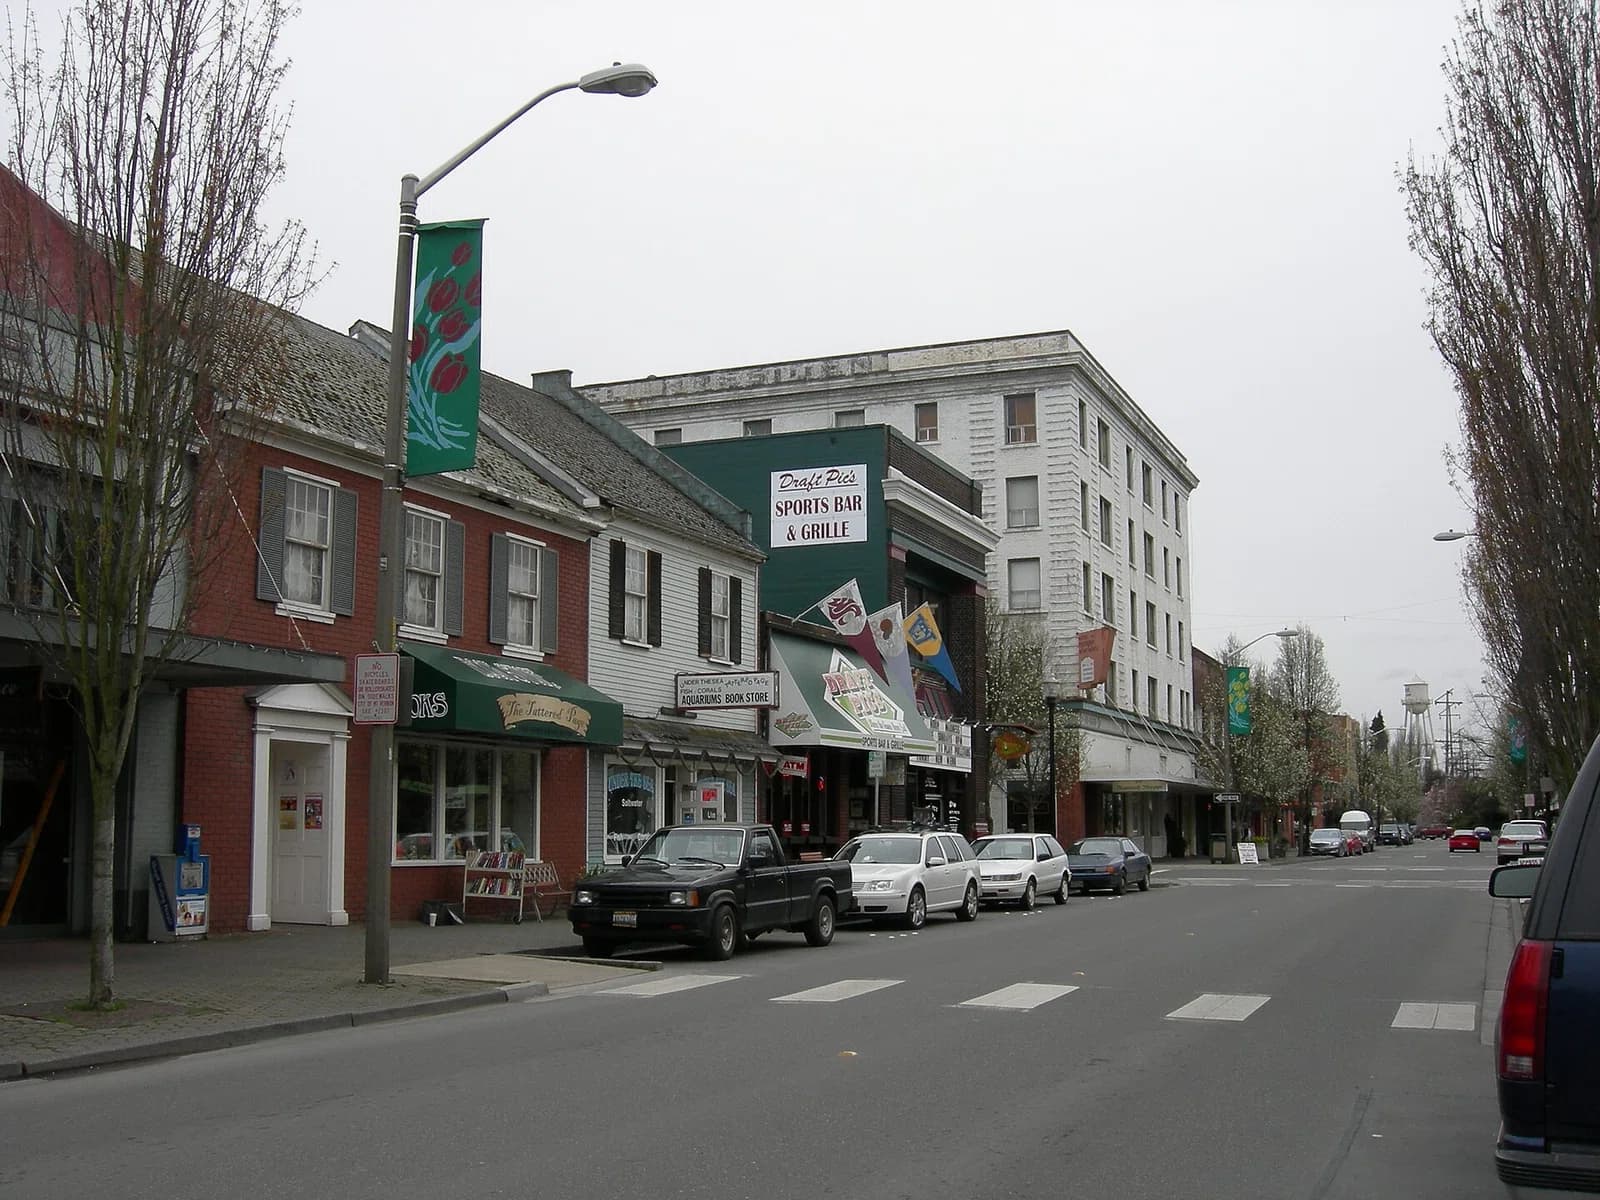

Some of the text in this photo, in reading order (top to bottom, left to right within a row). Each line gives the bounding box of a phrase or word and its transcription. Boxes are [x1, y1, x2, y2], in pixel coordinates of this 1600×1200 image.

[780, 473, 822, 492] Draft
[775, 495, 862, 517] SPORTS BAR
[786, 521, 850, 541] & GRILLE
[679, 679, 700, 688] UNDER
[681, 692, 769, 705] AQUARIUMS BOOK STORE
[507, 699, 524, 716] The
[525, 701, 562, 720] Tattered
[783, 761, 805, 771] ATM
[621, 798, 643, 807] Saltwater
